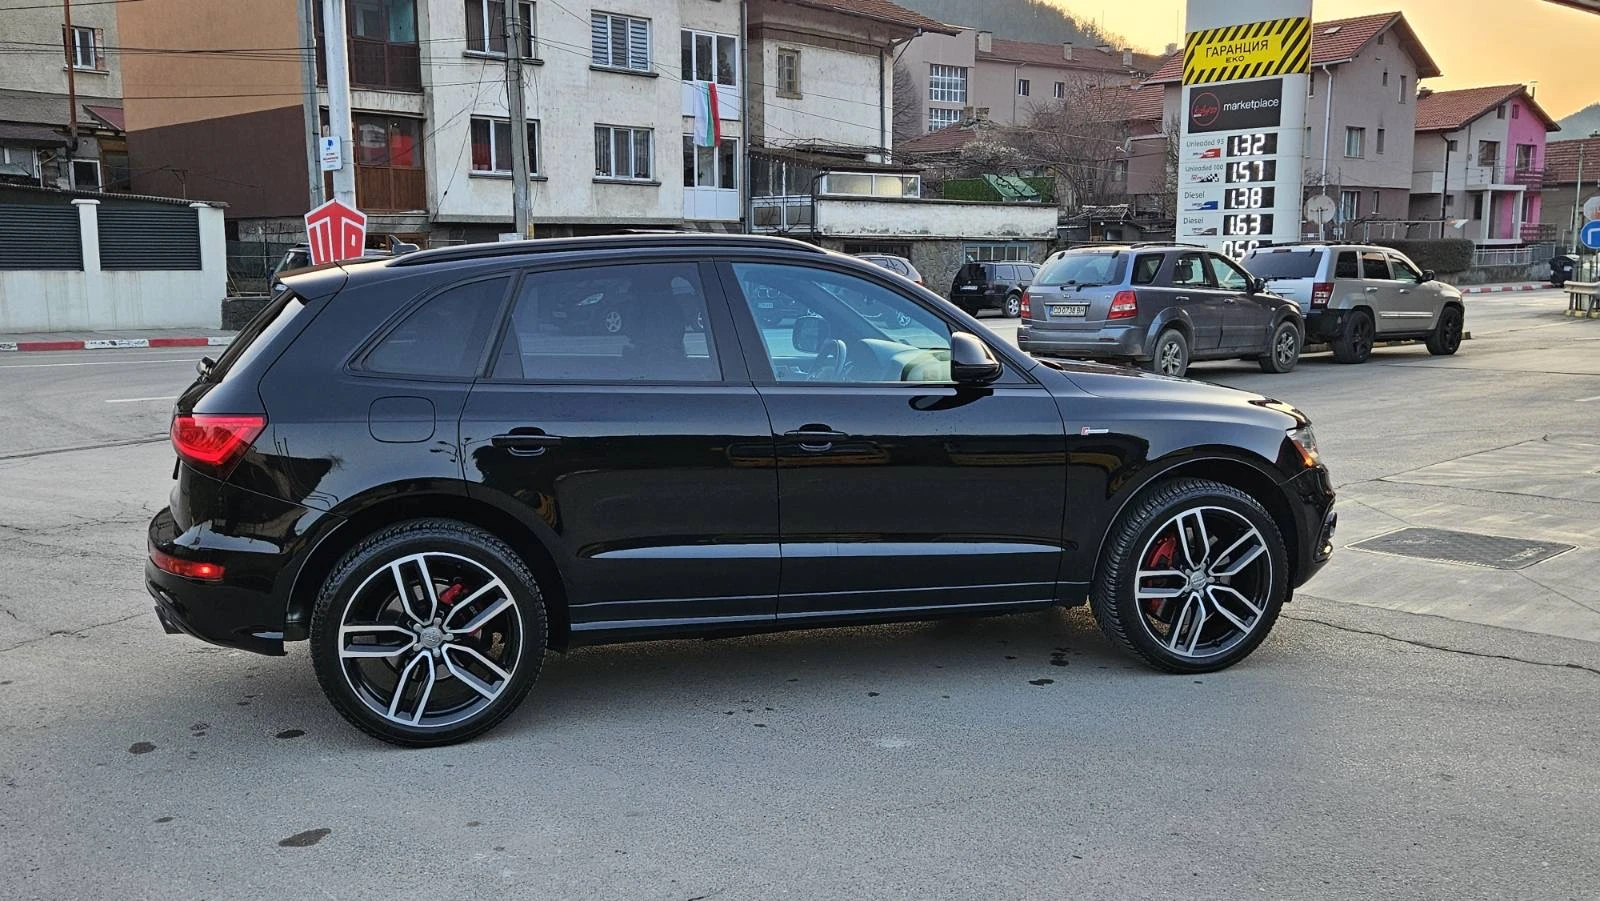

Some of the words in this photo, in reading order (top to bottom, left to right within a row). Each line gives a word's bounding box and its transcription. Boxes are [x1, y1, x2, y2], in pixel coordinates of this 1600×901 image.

[1206, 40, 1268, 57] ГАРАНЦИЯ
[1223, 98, 1279, 111] marketplace
[1186, 140, 1214, 148] Unleaded
[1234, 134, 1265, 156] 1.32
[1233, 160, 1264, 182] 1.57
[1184, 191, 1205, 199] Diesel
[1231, 187, 1262, 209] 1.38
[1183, 217, 1204, 225] Diesel
[1230, 214, 1261, 235] 1.63
